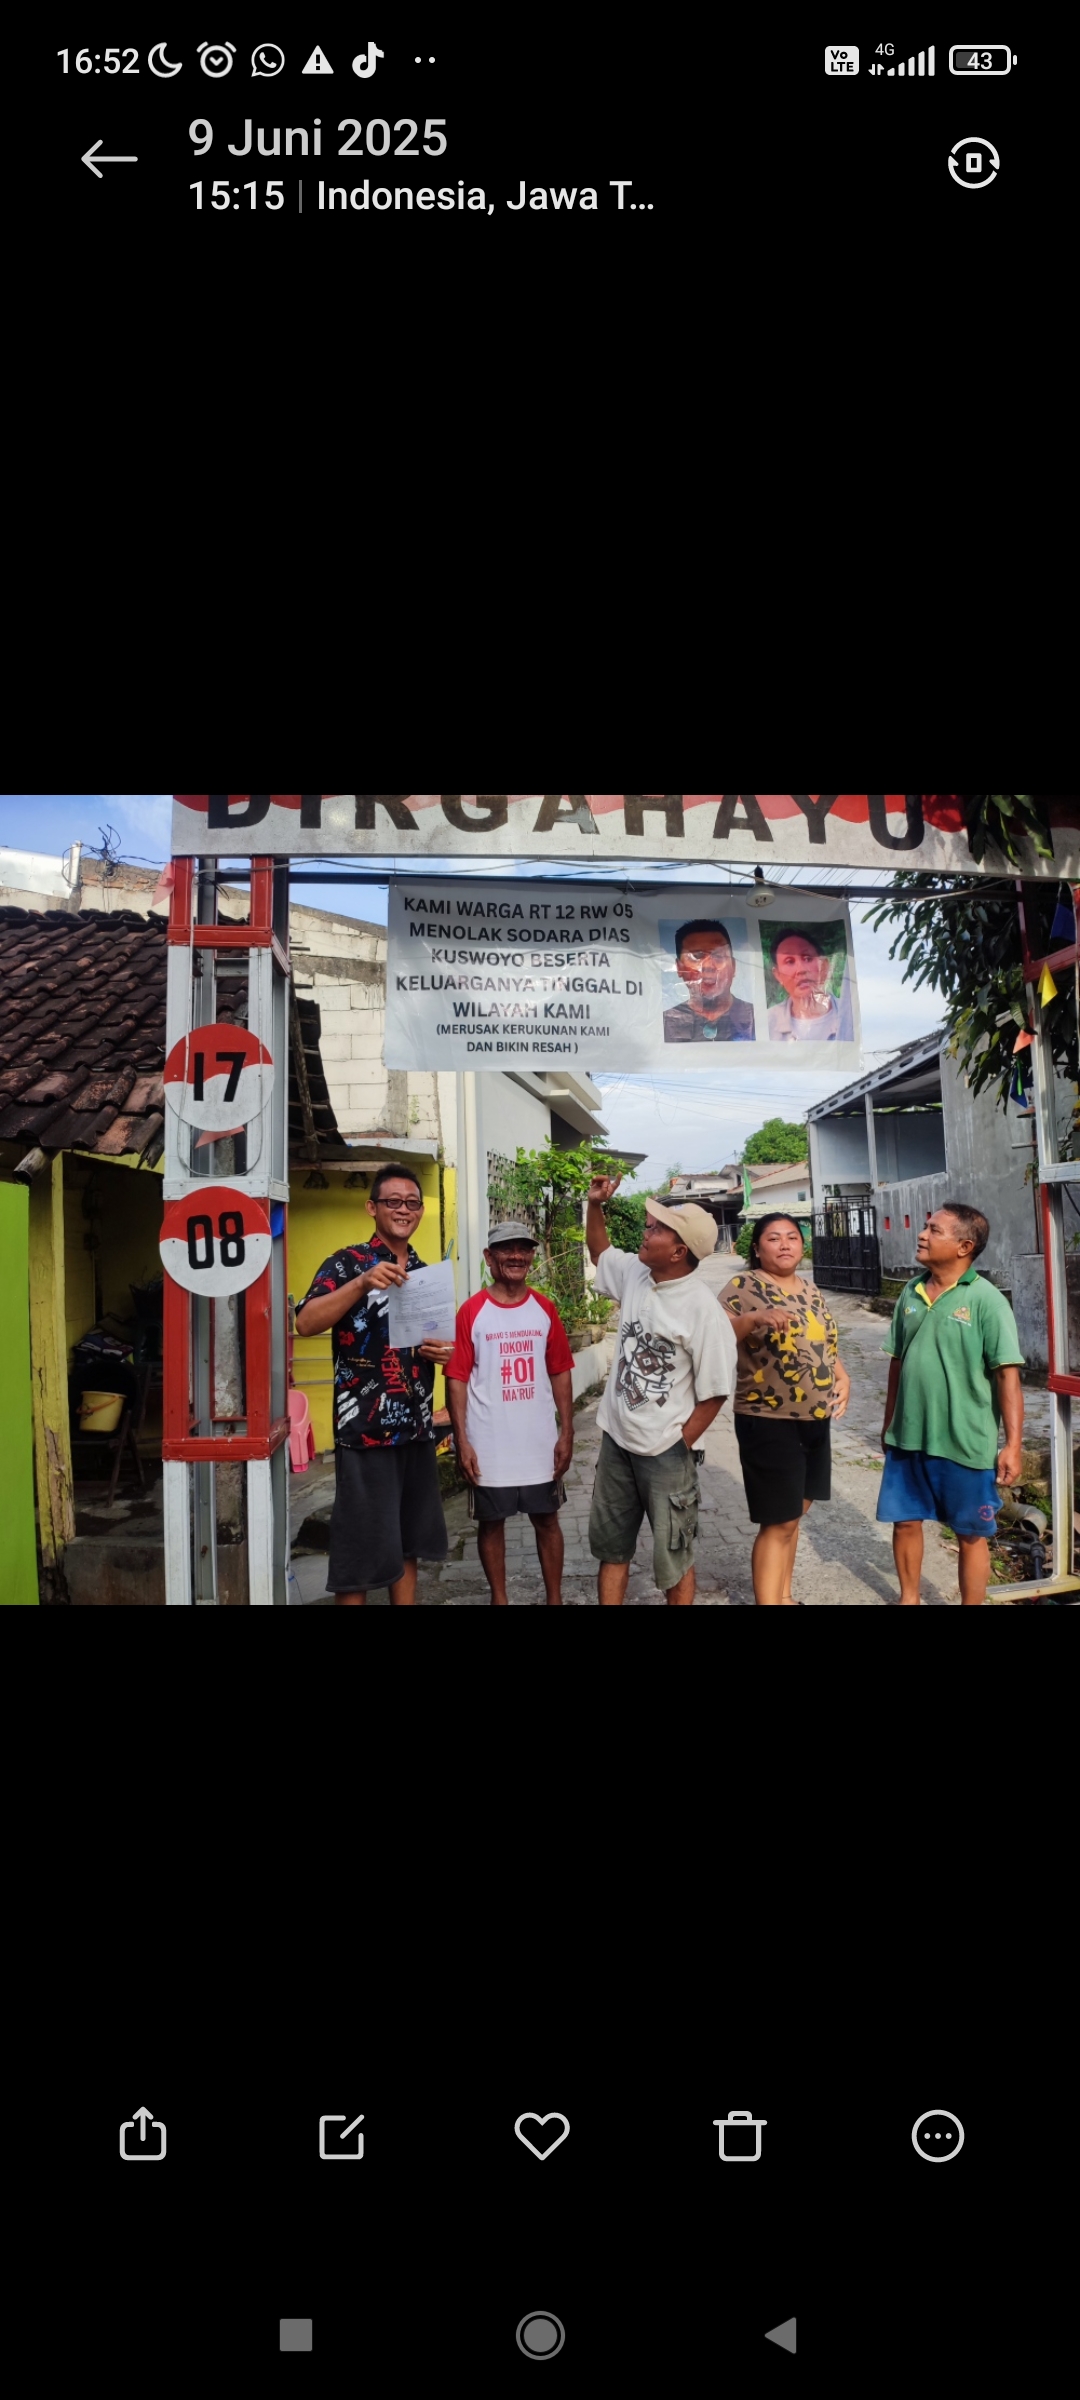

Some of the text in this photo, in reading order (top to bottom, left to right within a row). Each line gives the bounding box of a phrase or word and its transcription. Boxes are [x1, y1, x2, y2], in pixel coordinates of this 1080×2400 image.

[404, 897, 634, 920] KAMI WARGA RT 12 RW 05
[409, 922, 631, 943] MENOLAK SODARA DIAS
[431, 948, 611, 968] KUSWOYO BESERTA
[396, 975, 643, 996] KELUARGANYA TINGGAL DI
[453, 1001, 591, 1019] WILAYAH KAMI
[436, 1024, 610, 1036] (MERUSAK KERUKUNAN KAMI
[466, 1042, 493, 1052] DAN
[496, 1042, 529, 1052] BIKIN
[532, 1042, 571, 1053] RESAH
[193, 1051, 247, 1103] 17
[186, 1211, 246, 1270] 08
[500, 1340, 534, 1354] JOKOWI
[501, 1356, 535, 1385] #01
[502, 1387, 535, 1402] MA'RUF
